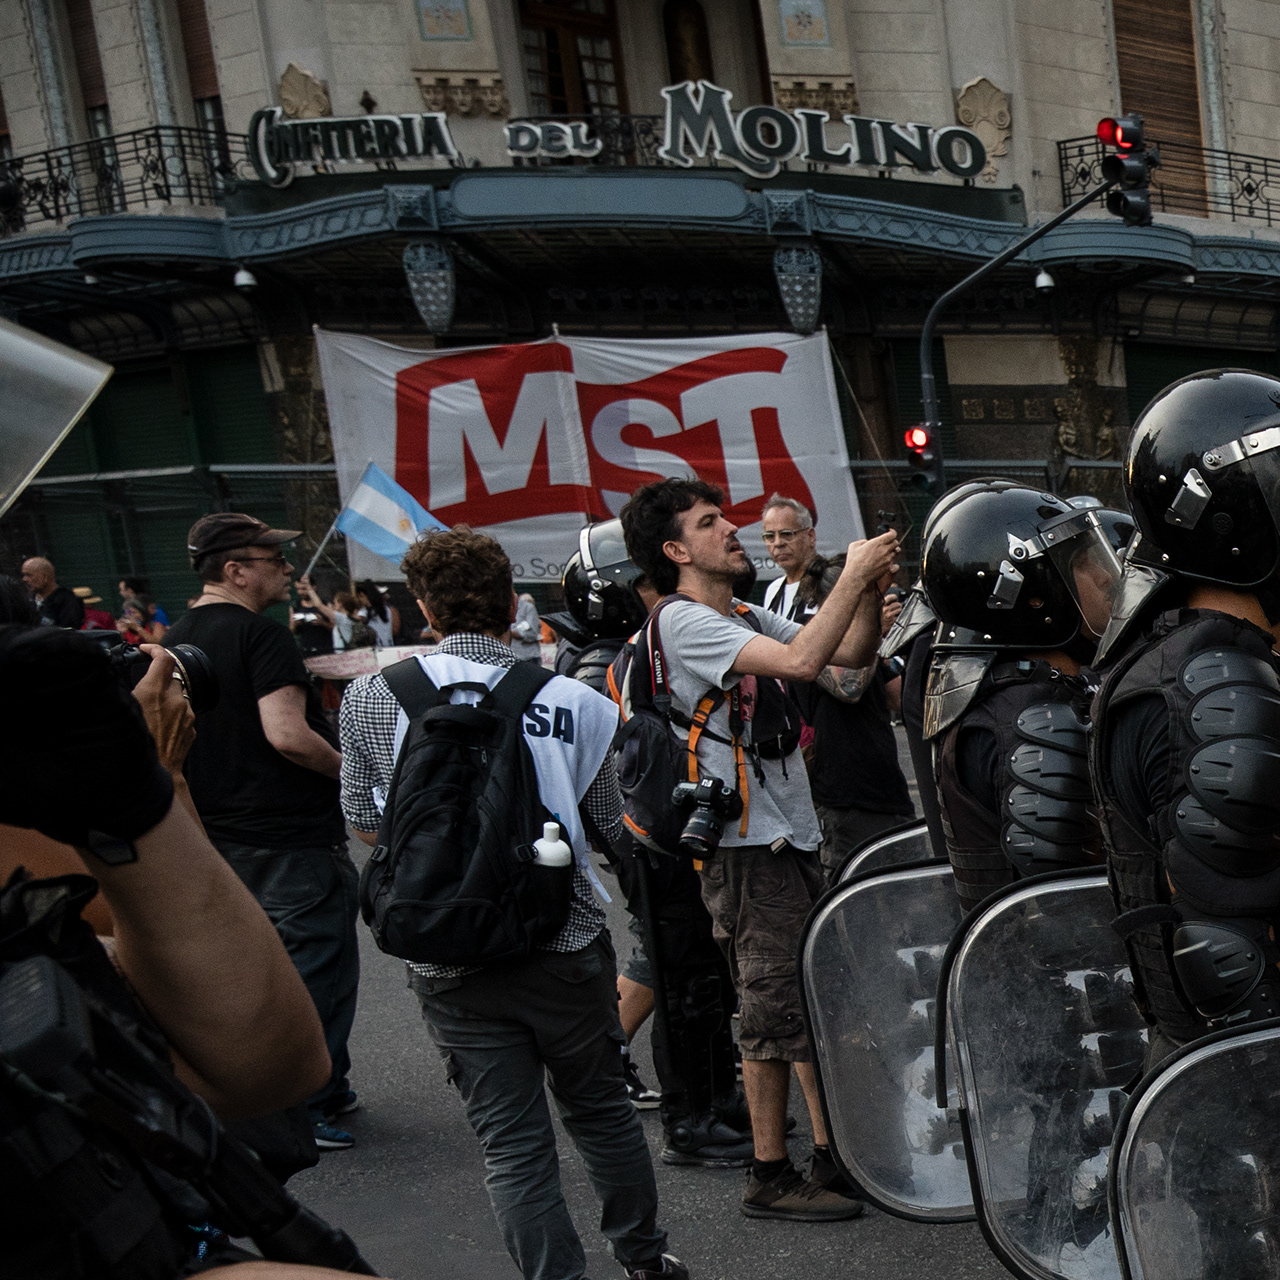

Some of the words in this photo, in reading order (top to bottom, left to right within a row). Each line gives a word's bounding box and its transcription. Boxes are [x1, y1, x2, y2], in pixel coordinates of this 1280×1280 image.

[503, 120, 602, 158] DEL
[658, 79, 988, 179] MOLINO
[428, 370, 784, 517] MST
